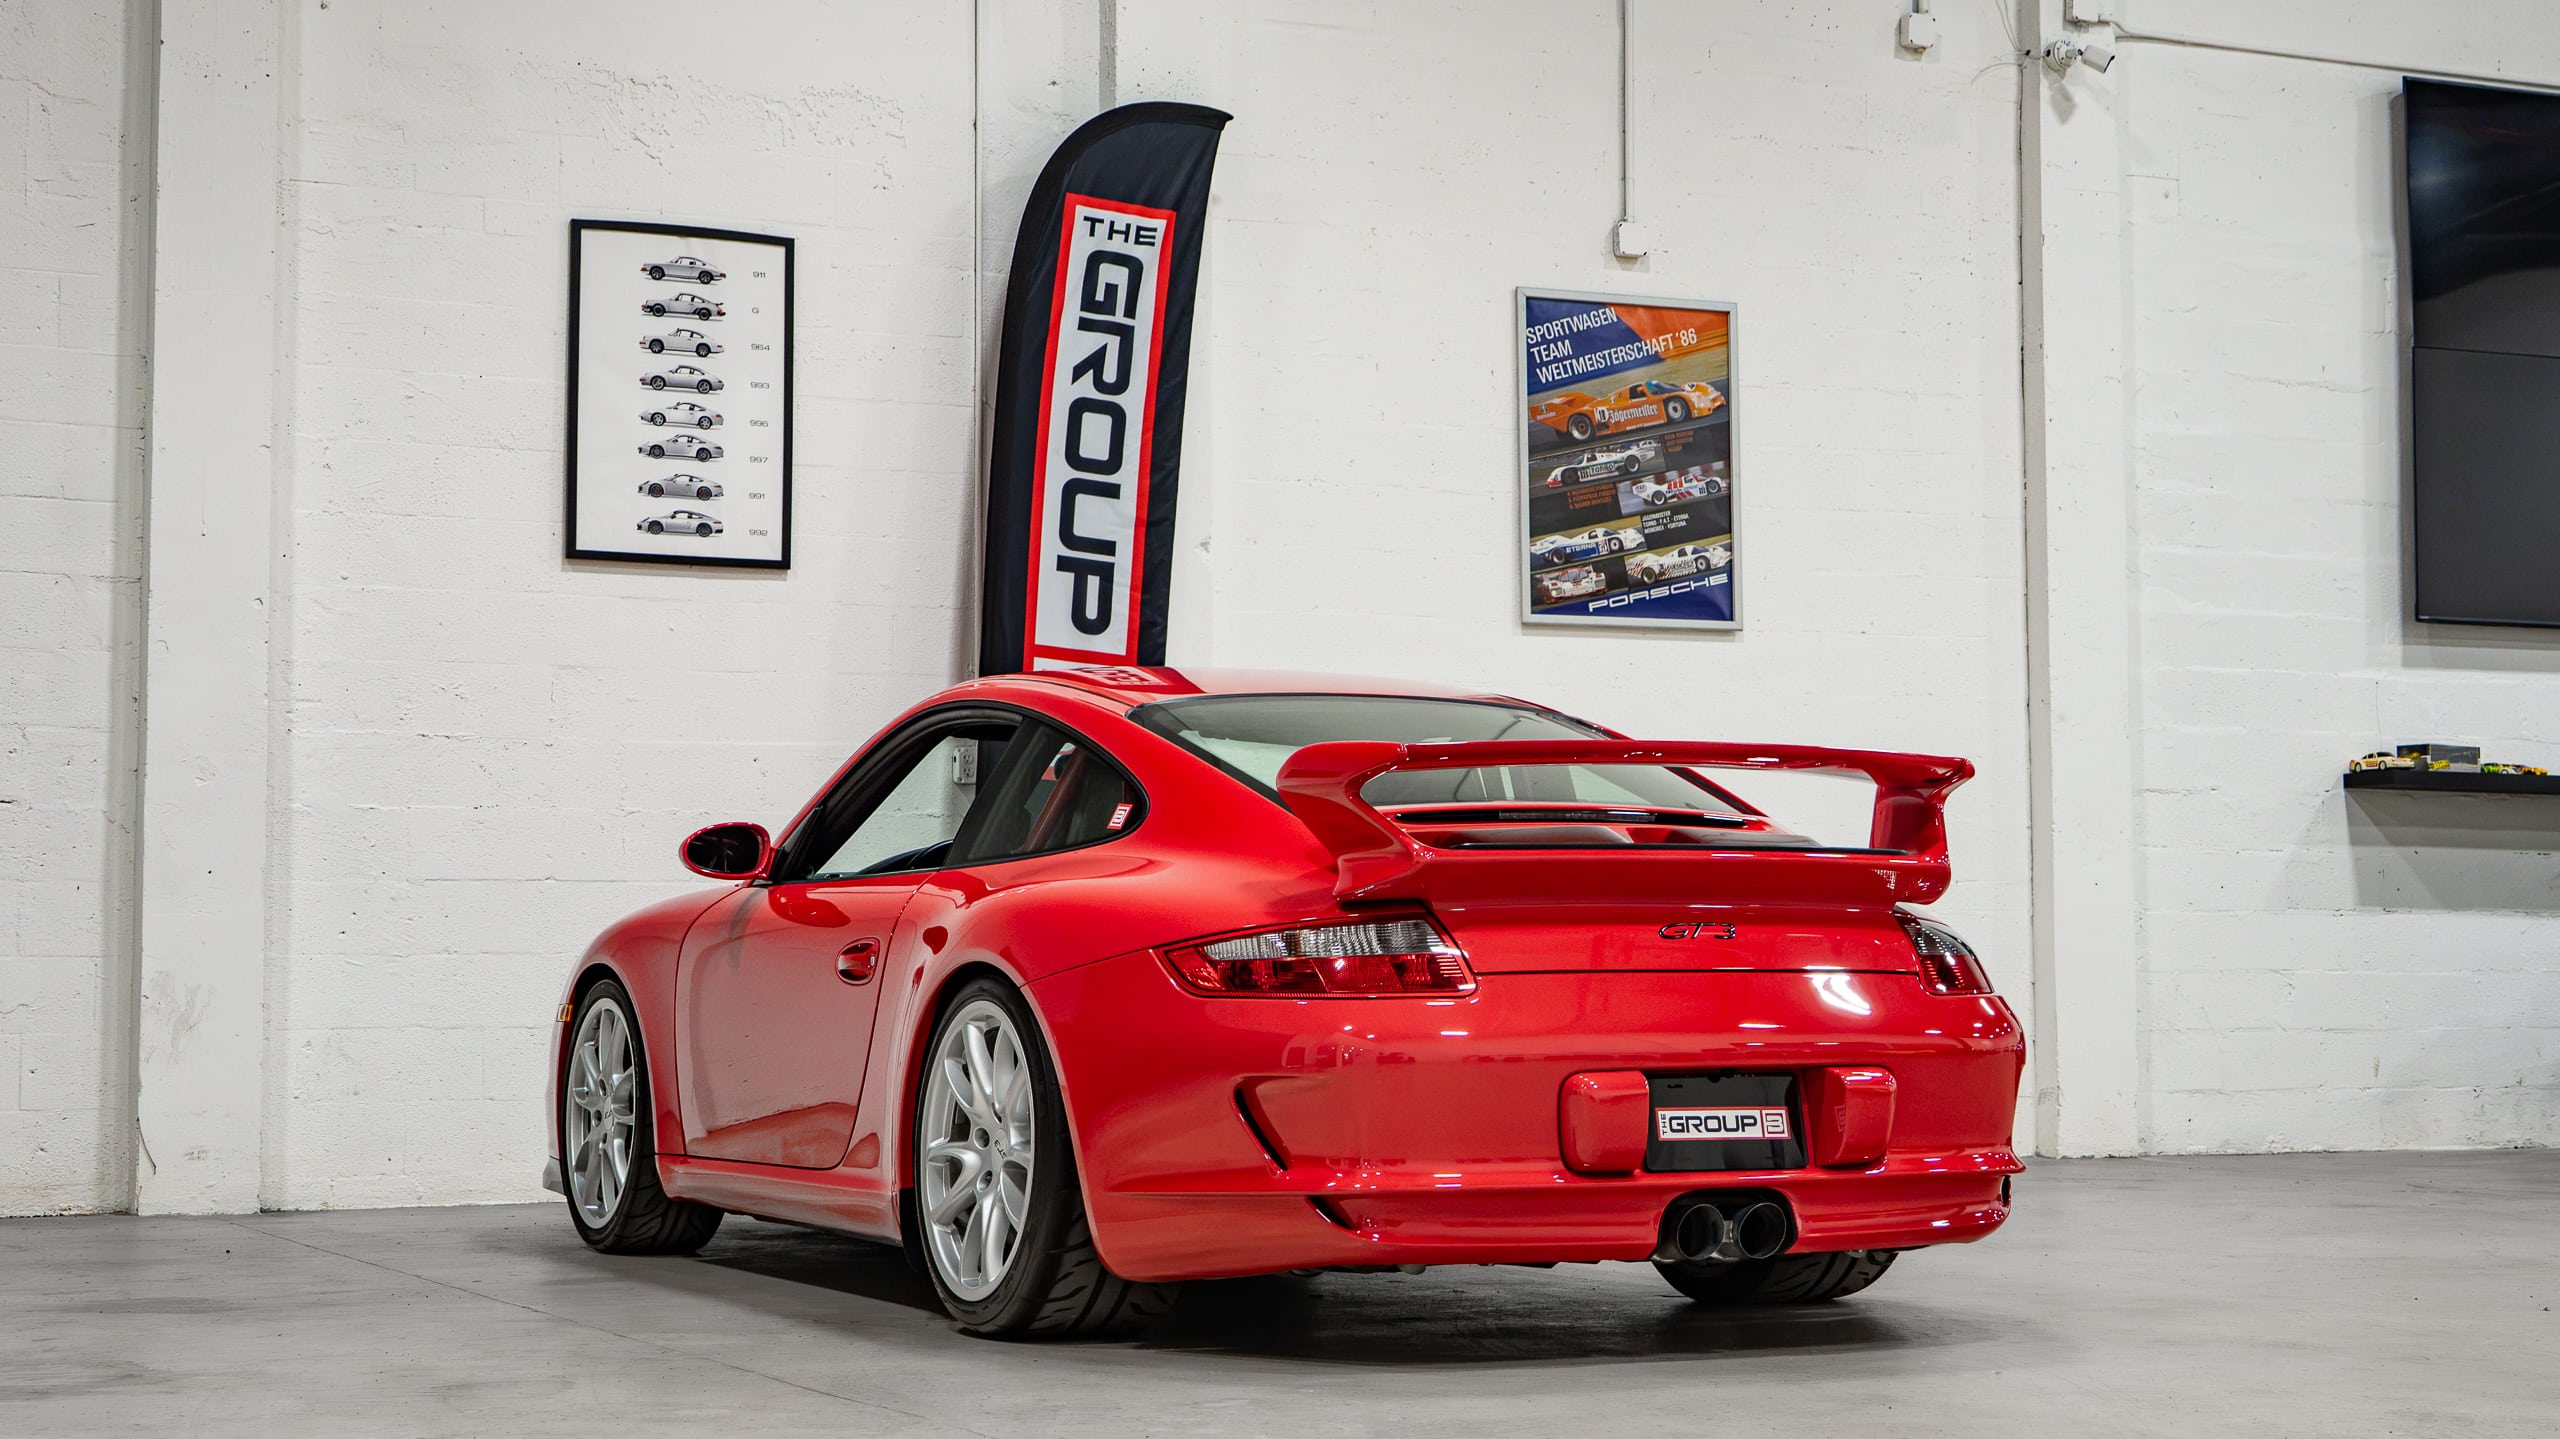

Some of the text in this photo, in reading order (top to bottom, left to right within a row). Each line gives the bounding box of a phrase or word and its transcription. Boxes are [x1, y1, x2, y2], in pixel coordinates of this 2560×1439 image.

[1083, 215, 1158, 247] THE
[1526, 307, 1618, 345] SPORTWAGEN
[751, 343, 770, 351] 964
[1530, 339, 1573, 364] TEAM
[1535, 333, 1673, 384] WELTMEISTERSCHAFT
[750, 381, 769, 389] 993
[749, 419, 769, 427] 996
[1056, 249, 1144, 637] GROUP
[748, 528, 768, 536] 992
[1588, 573, 1728, 613] PORSCHE
[1658, 922, 1736, 939] GT3
[1668, 1115, 1758, 1133] GROUP
